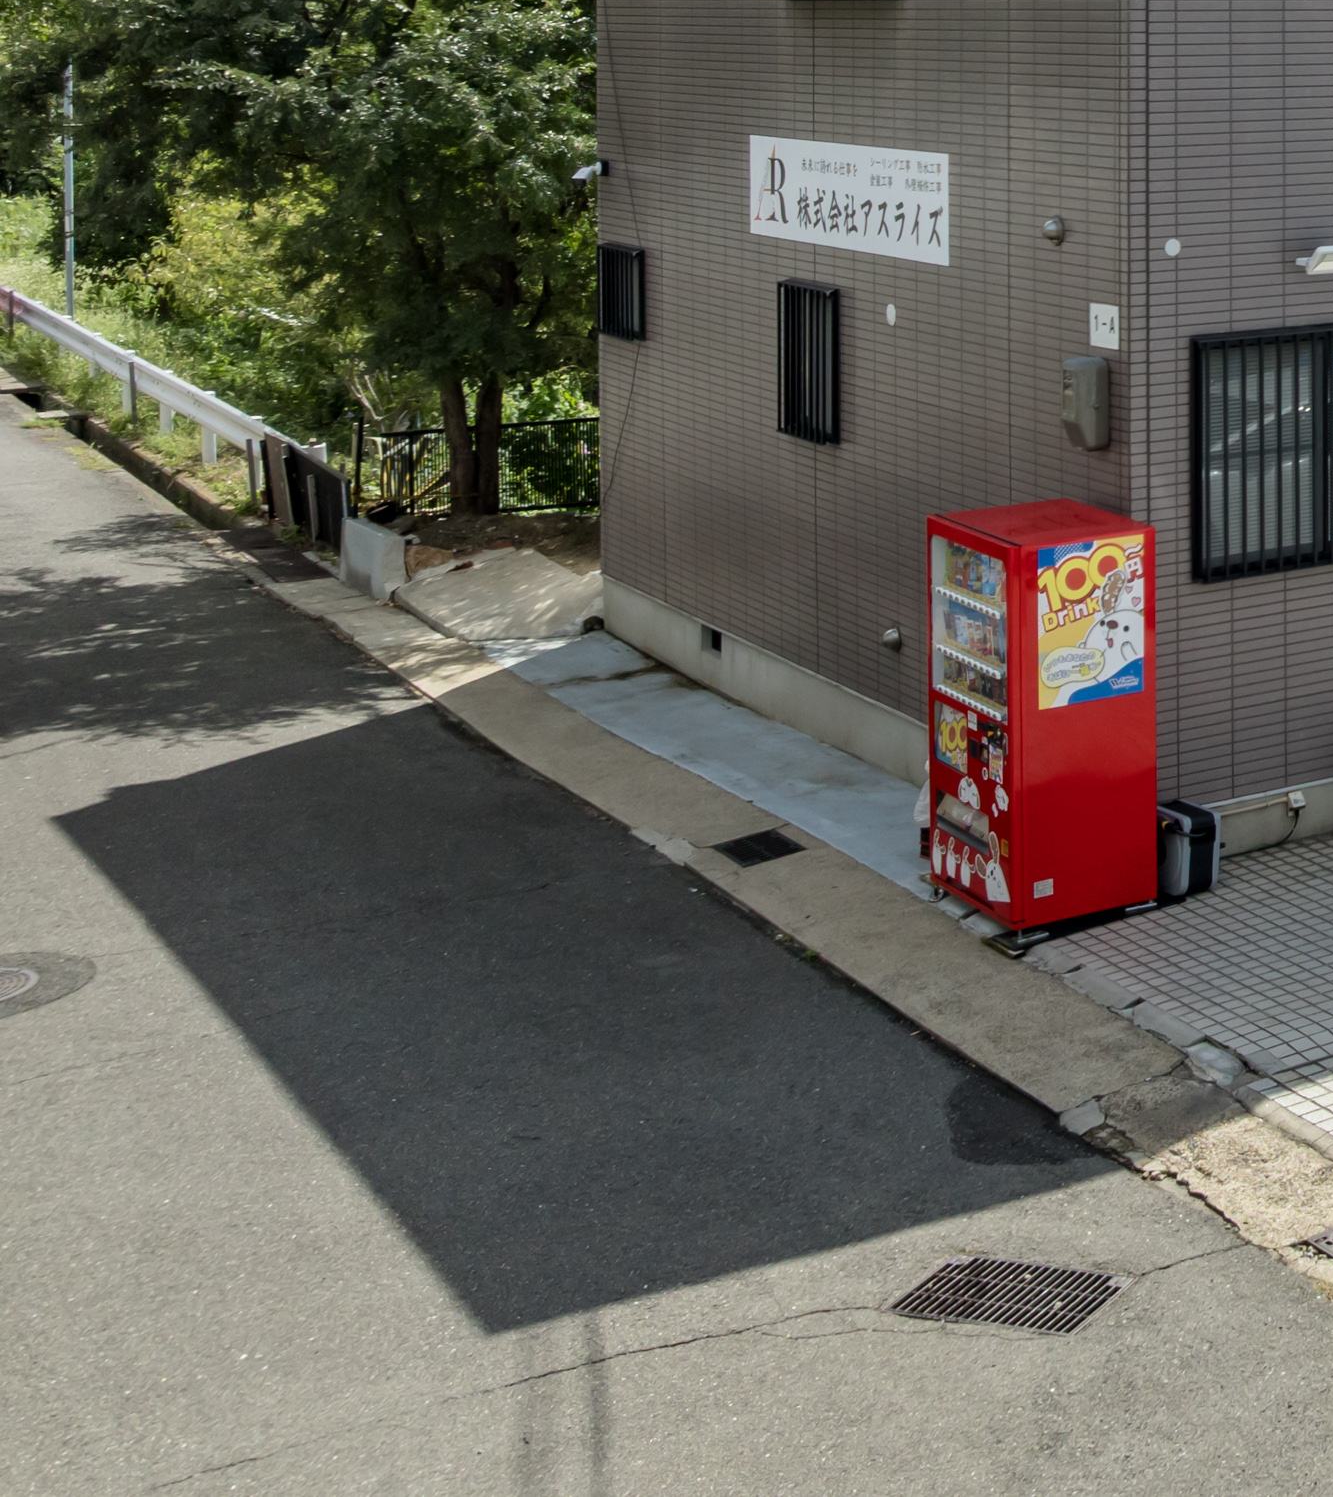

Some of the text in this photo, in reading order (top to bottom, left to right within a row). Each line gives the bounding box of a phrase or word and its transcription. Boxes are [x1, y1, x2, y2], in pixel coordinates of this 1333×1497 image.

[797, 187, 944, 248] 株式会社アスライズ
[1094, 314, 1116, 334] 1-A
[1042, 597, 1101, 633] Drink
